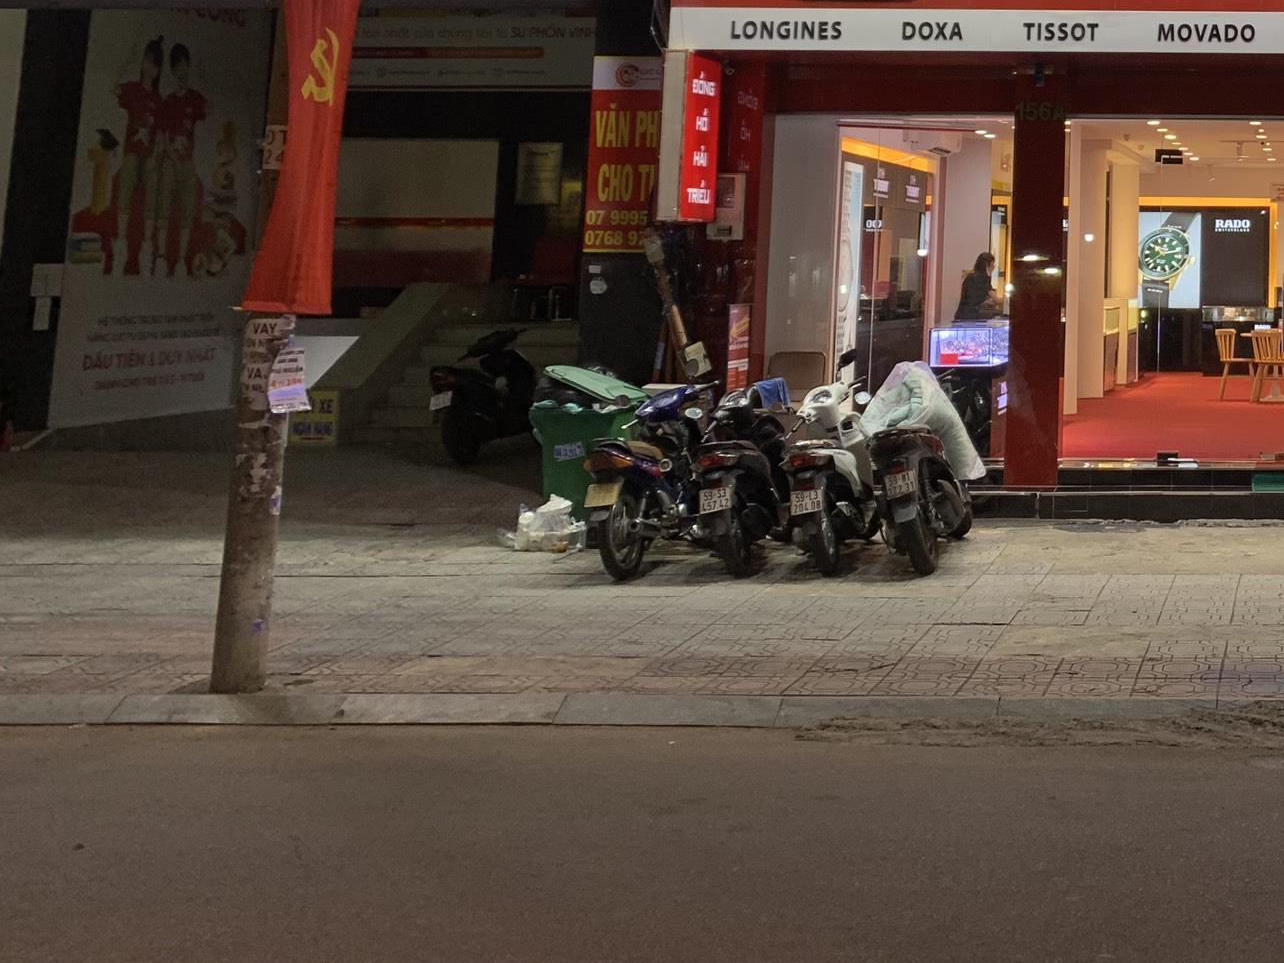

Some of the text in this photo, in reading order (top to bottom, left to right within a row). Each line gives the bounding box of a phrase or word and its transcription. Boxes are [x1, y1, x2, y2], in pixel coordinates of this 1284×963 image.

[730, 19, 843, 41] LONGINES
[902, 21, 964, 42] DOXA
[1023, 22, 1099, 42] TISSOT
[1157, 23, 1256, 43] MOVADO
[595, 102, 659, 149] VĂN PH
[597, 163, 635, 202] CHO
[586, 209, 607, 226] 07
[1214, 218, 1250, 229] RADO
[584, 230, 623, 246] 0768
[252, 322, 278, 335] VAY
[247, 367, 265, 379] VA
